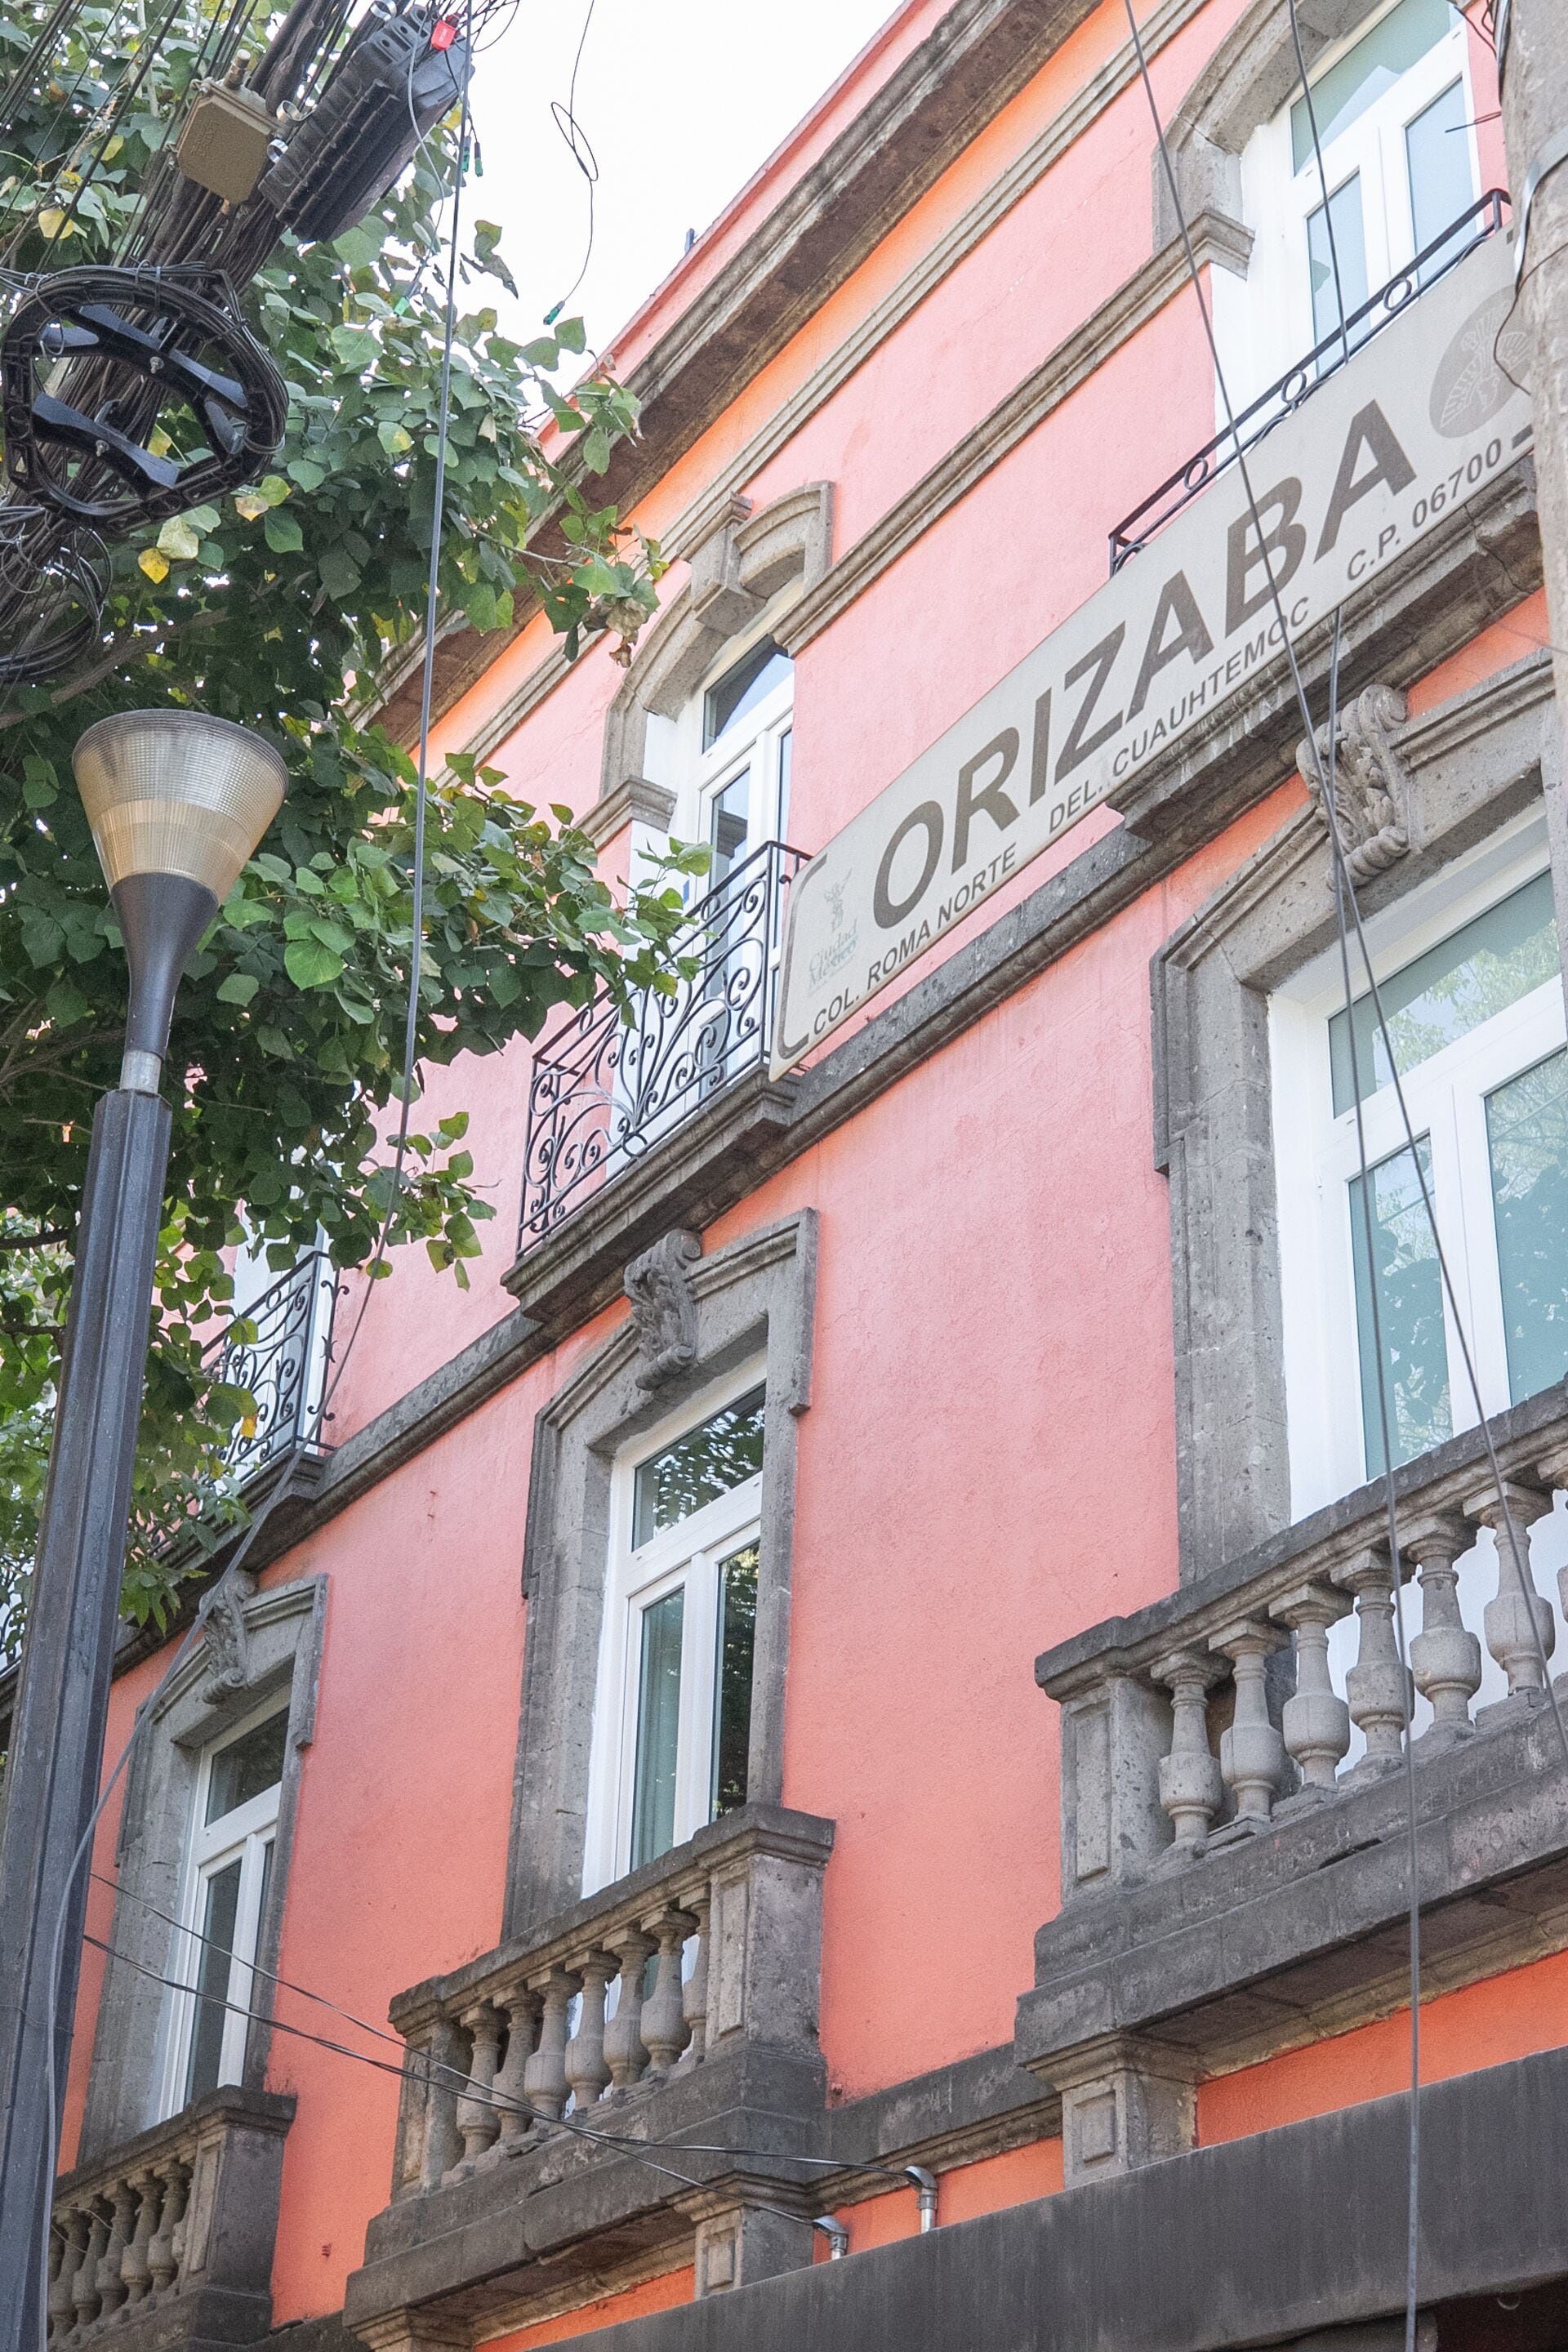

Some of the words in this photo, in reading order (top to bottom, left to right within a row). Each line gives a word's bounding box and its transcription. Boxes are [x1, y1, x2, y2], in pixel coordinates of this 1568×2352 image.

[813, 987, 861, 1036] COL.
[866, 920, 931, 991] ROMA
[937, 842, 1017, 929] NORTE
[1049, 779, 1103, 834] DEL.
[1113, 597, 1309, 777] CUAUHTEMOC
[1347, 525, 1401, 581] C.P.
[1412, 438, 1503, 529] 06700
[873, 399, 1418, 929] ORIZABA
